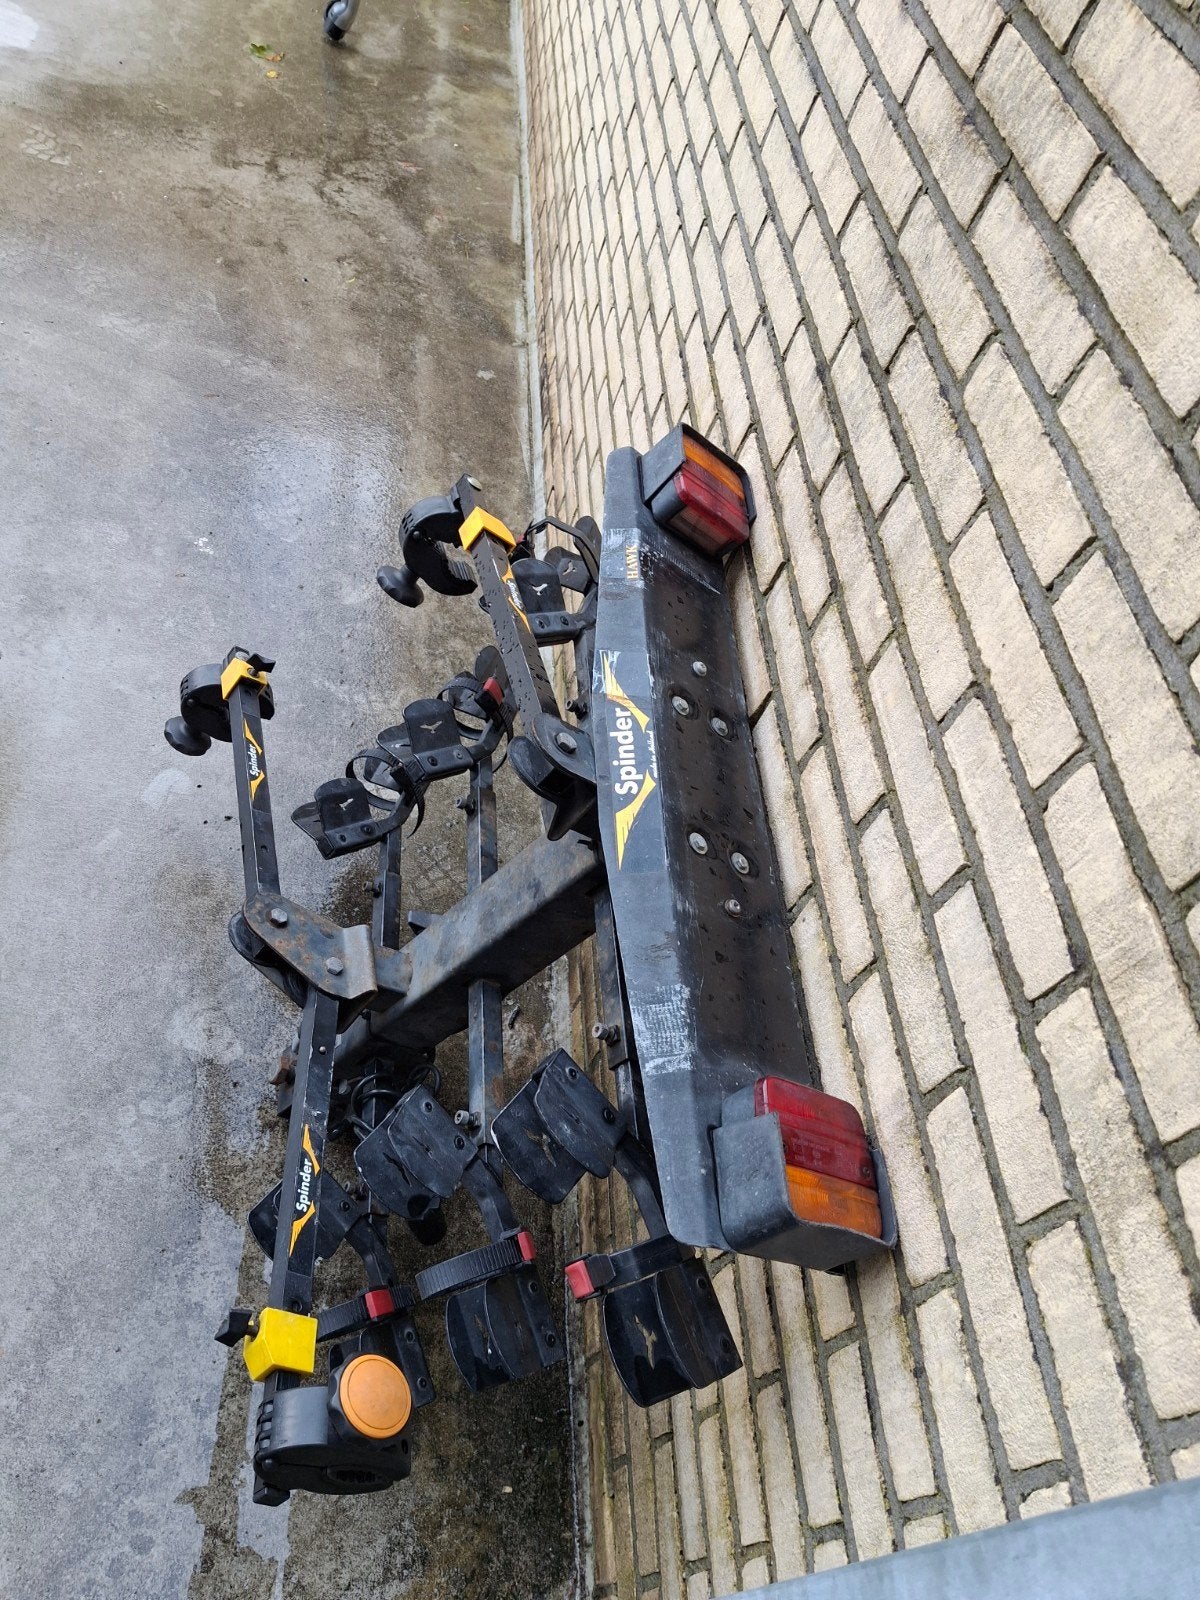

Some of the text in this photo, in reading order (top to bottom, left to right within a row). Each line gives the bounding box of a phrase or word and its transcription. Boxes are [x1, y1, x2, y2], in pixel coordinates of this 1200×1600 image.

[626, 544, 639, 579] HAWK
[247, 744, 260, 776] Spinder
[610, 708, 642, 794] Spinder
[295, 1158, 312, 1212] Spinder
